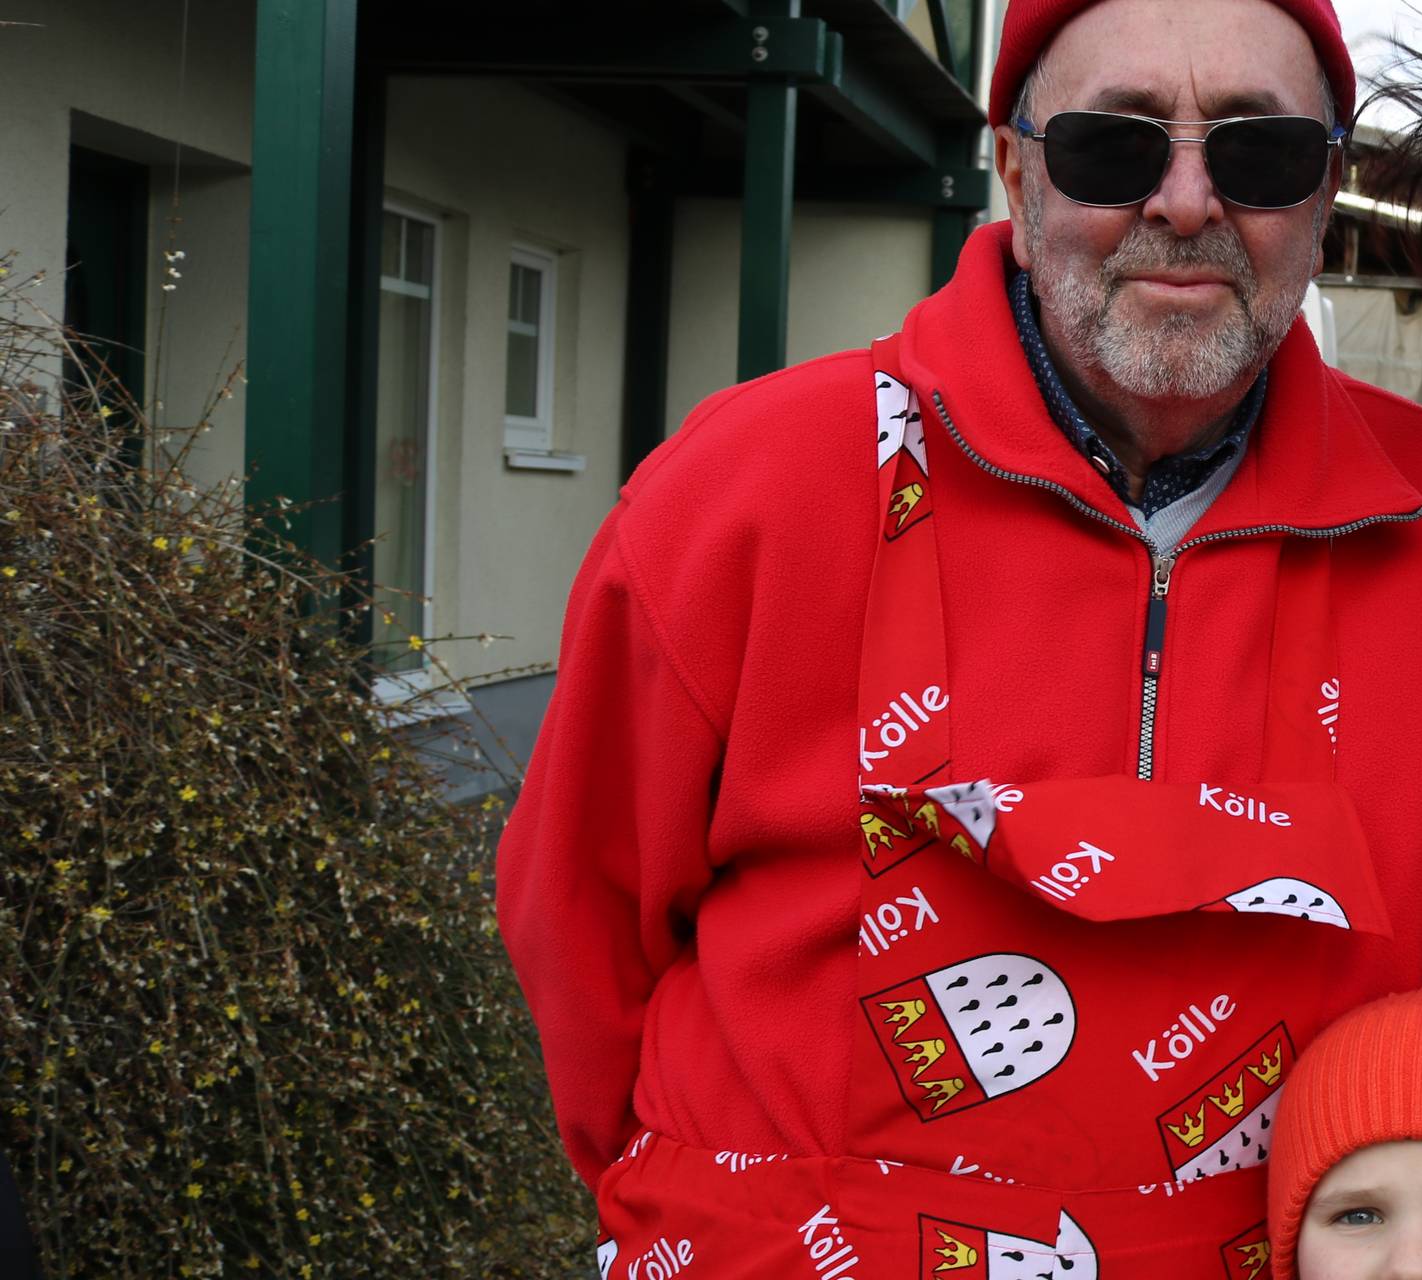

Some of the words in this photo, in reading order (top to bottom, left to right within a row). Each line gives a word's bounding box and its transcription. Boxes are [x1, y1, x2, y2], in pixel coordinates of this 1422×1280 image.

[859, 685, 950, 772] Kölle
[1199, 783, 1293, 827] Kölle
[1030, 840, 1116, 901] Köll
[858, 886, 940, 957] Köll
[1132, 993, 1238, 1082] Kölle
